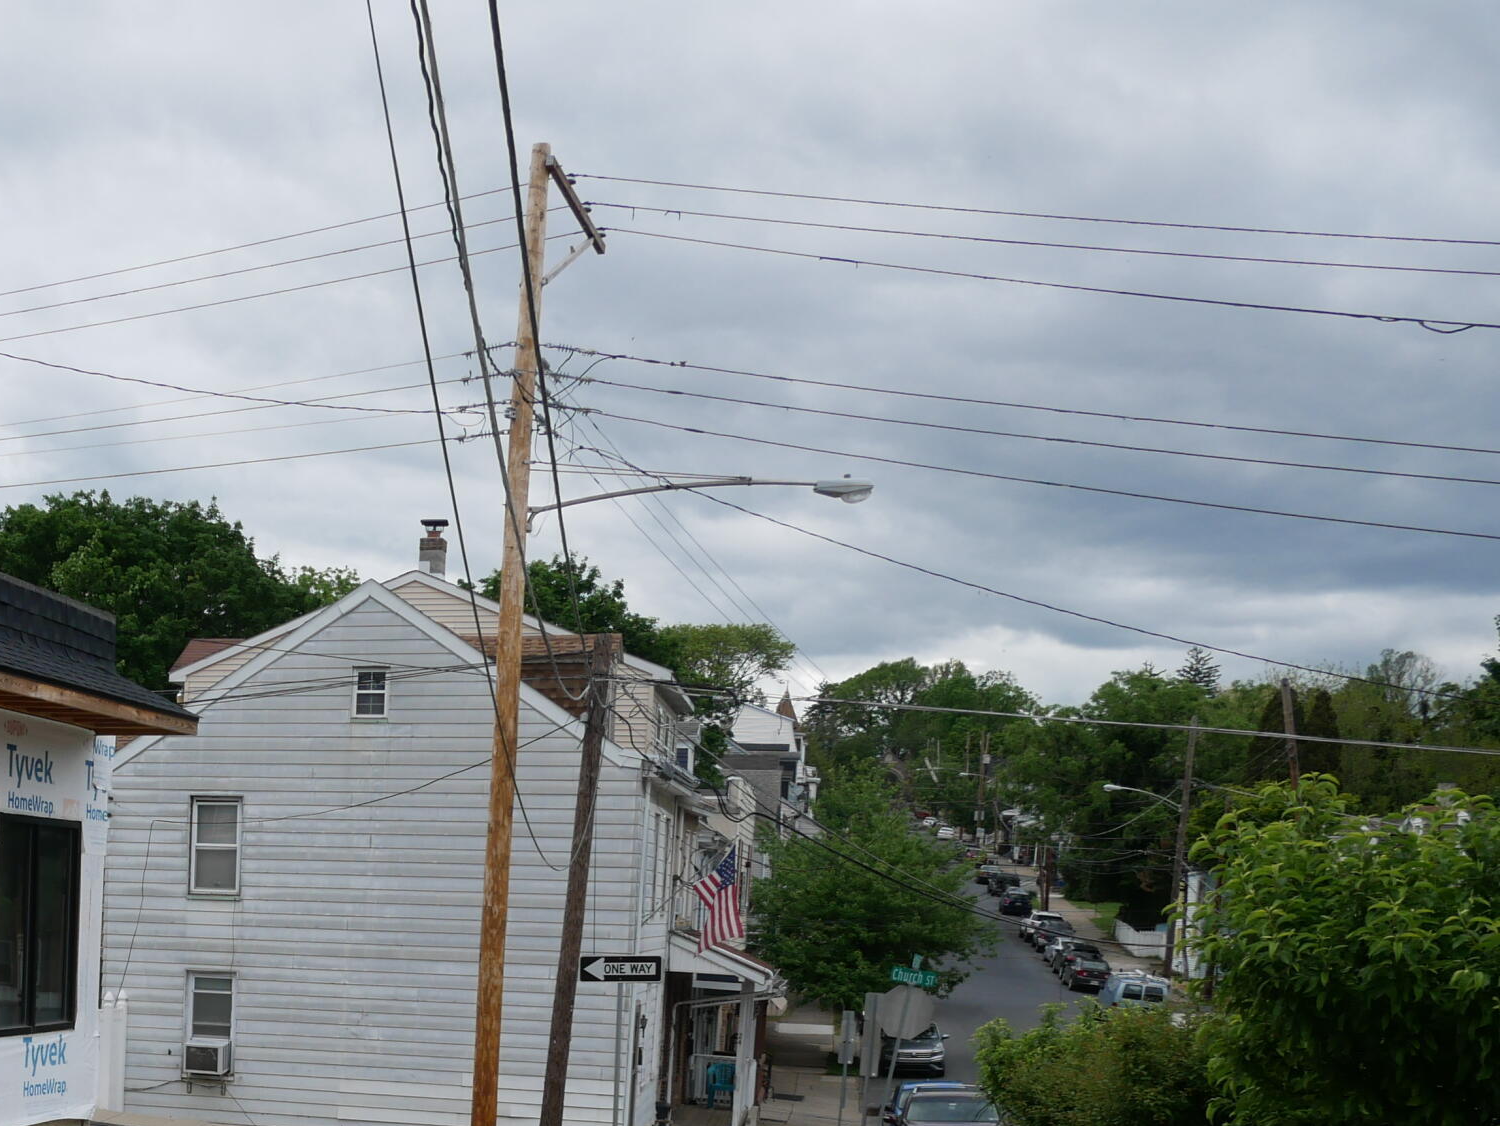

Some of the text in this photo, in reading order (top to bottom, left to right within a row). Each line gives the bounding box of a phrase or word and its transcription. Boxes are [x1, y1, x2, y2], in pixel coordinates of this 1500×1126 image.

[6, 743, 53, 789] Tyvek
[604, 963, 653, 975] ONE WAY
